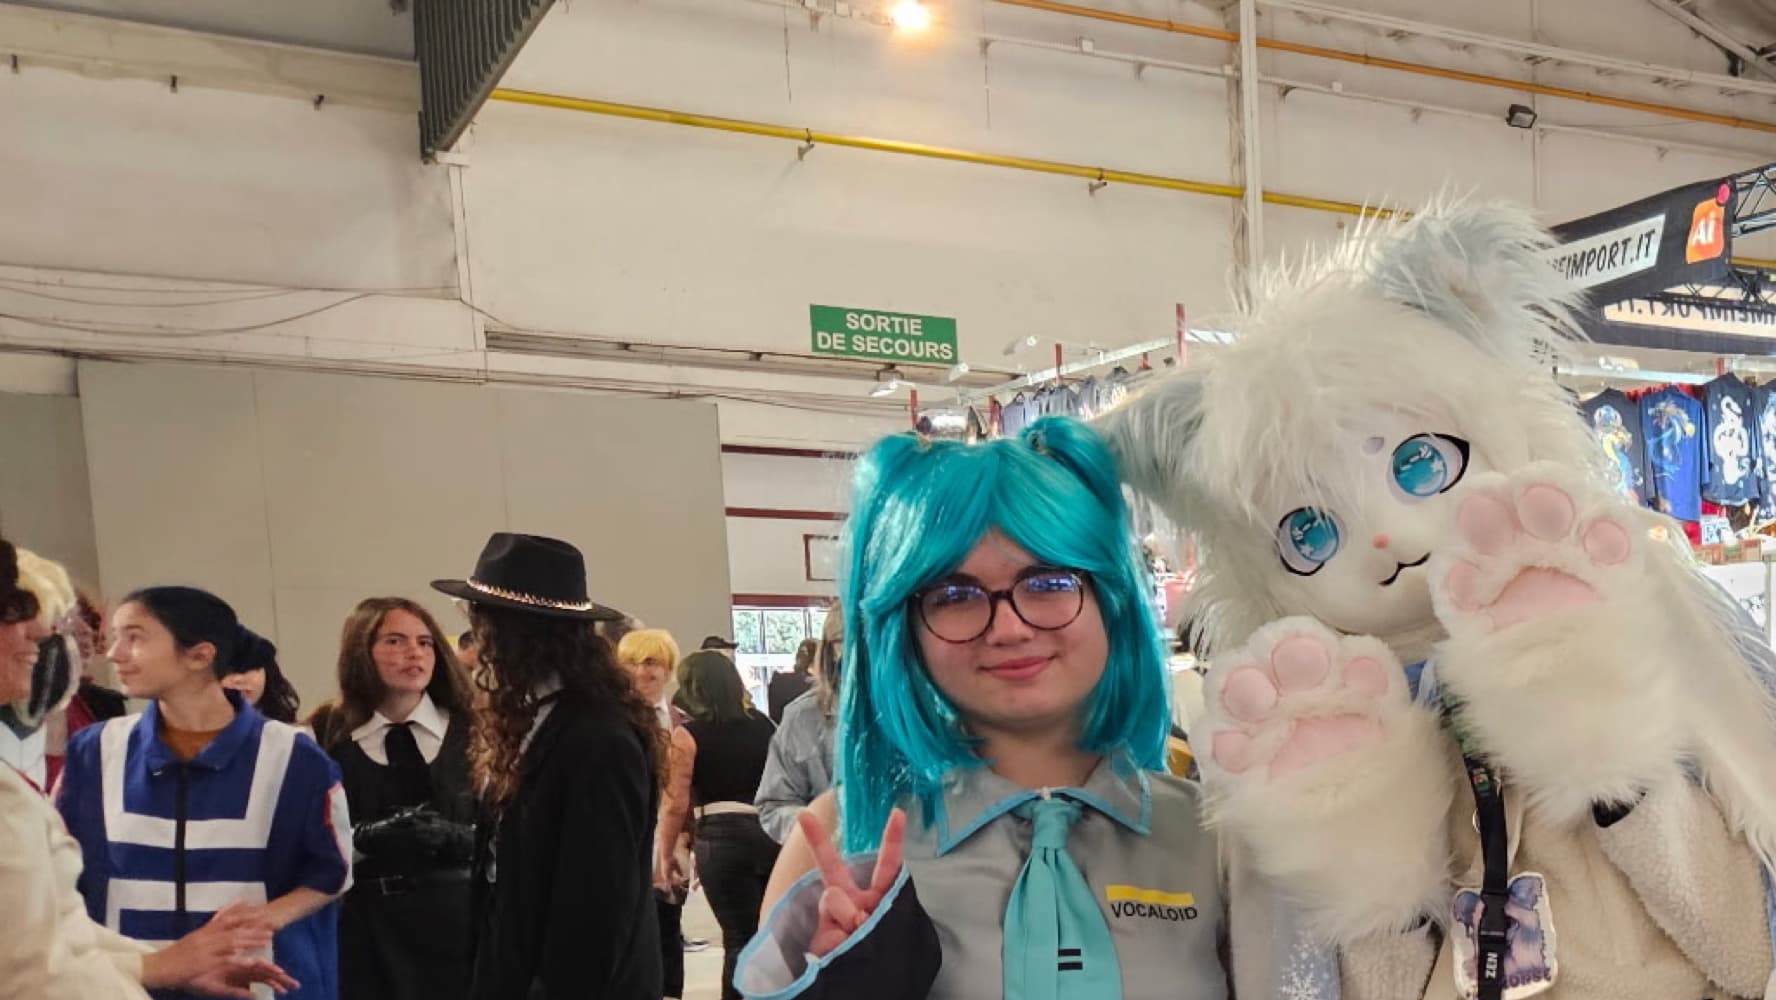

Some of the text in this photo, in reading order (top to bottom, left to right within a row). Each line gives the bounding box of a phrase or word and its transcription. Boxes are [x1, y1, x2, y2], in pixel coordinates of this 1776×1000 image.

[846, 312, 923, 336] SORTIE
[816, 332, 952, 360] DE SECOURS
[1111, 901, 1198, 921] VOCALOID
